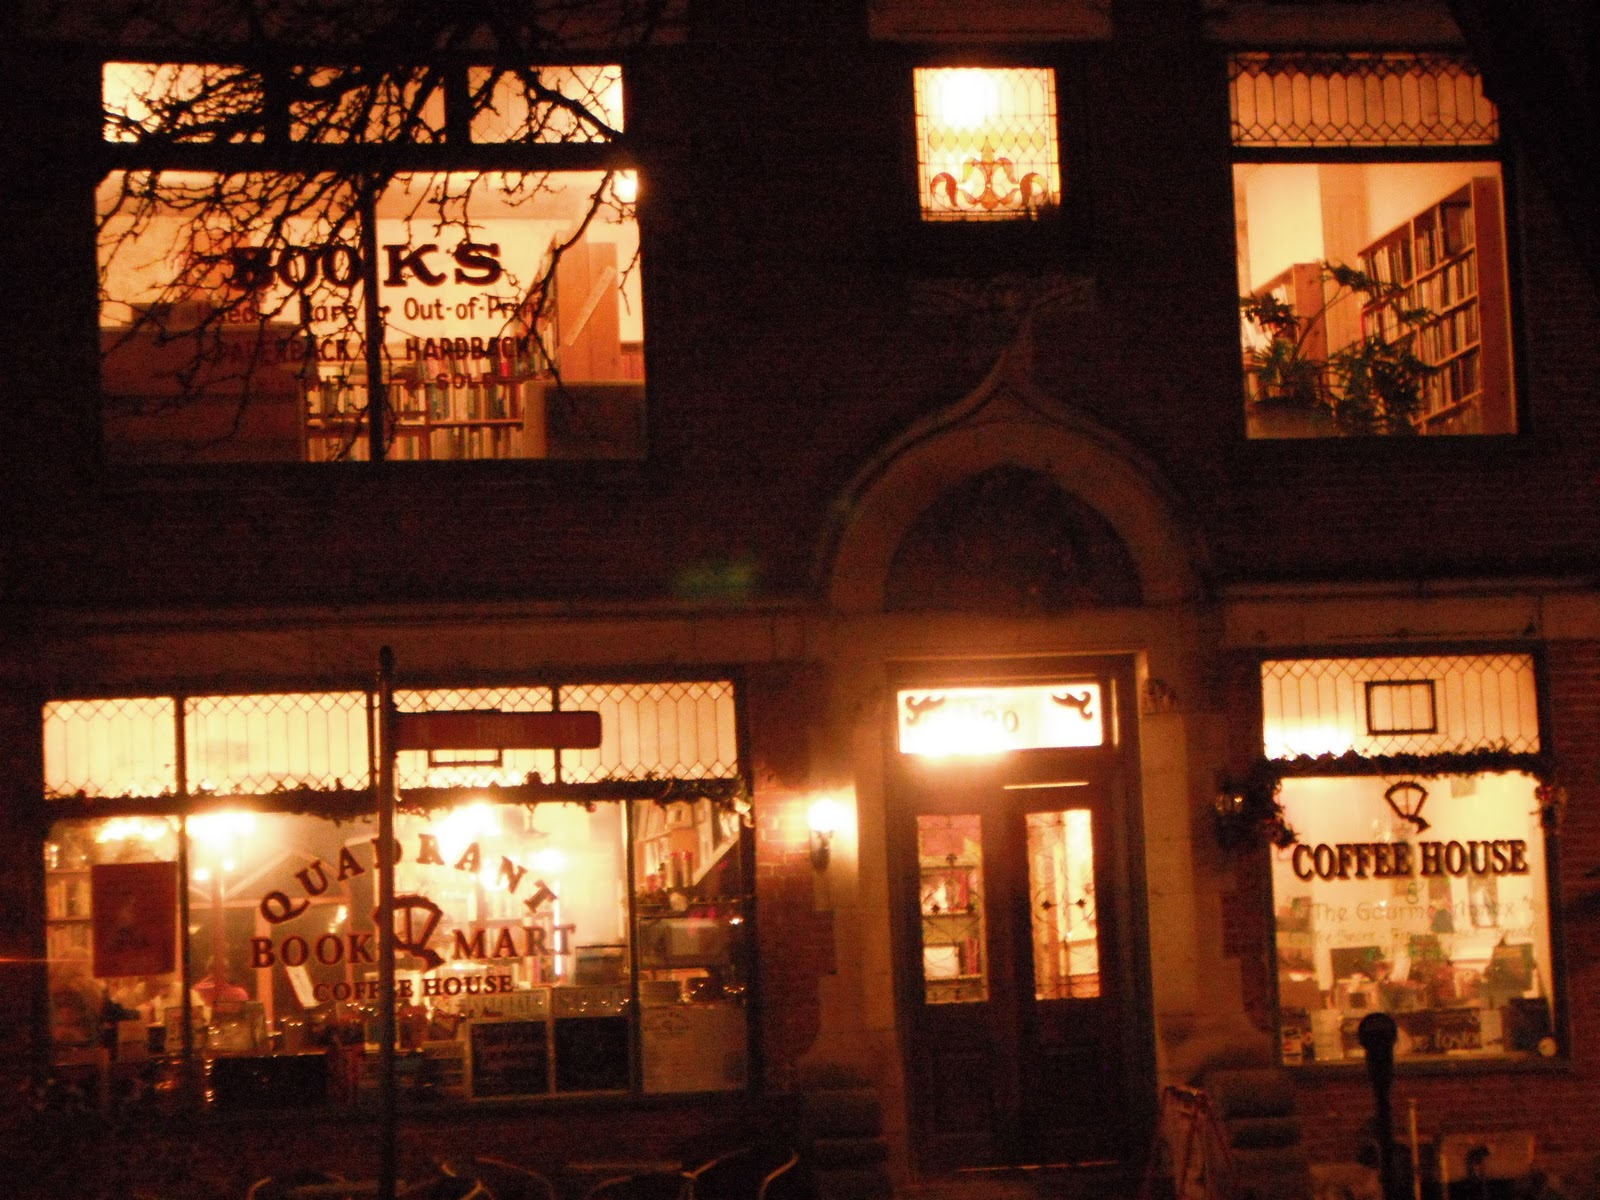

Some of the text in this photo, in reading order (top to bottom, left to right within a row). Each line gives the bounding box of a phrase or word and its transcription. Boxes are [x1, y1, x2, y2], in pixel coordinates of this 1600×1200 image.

[222, 242, 503, 289] BOOKS
[302, 302, 358, 322] are
[260, 833, 558, 925] QUADRANT
[1292, 840, 1530, 882] COFFEE HOUSE
[250, 923, 576, 968] BOOK MART
[313, 974, 514, 1002] COFFE HOUSE
